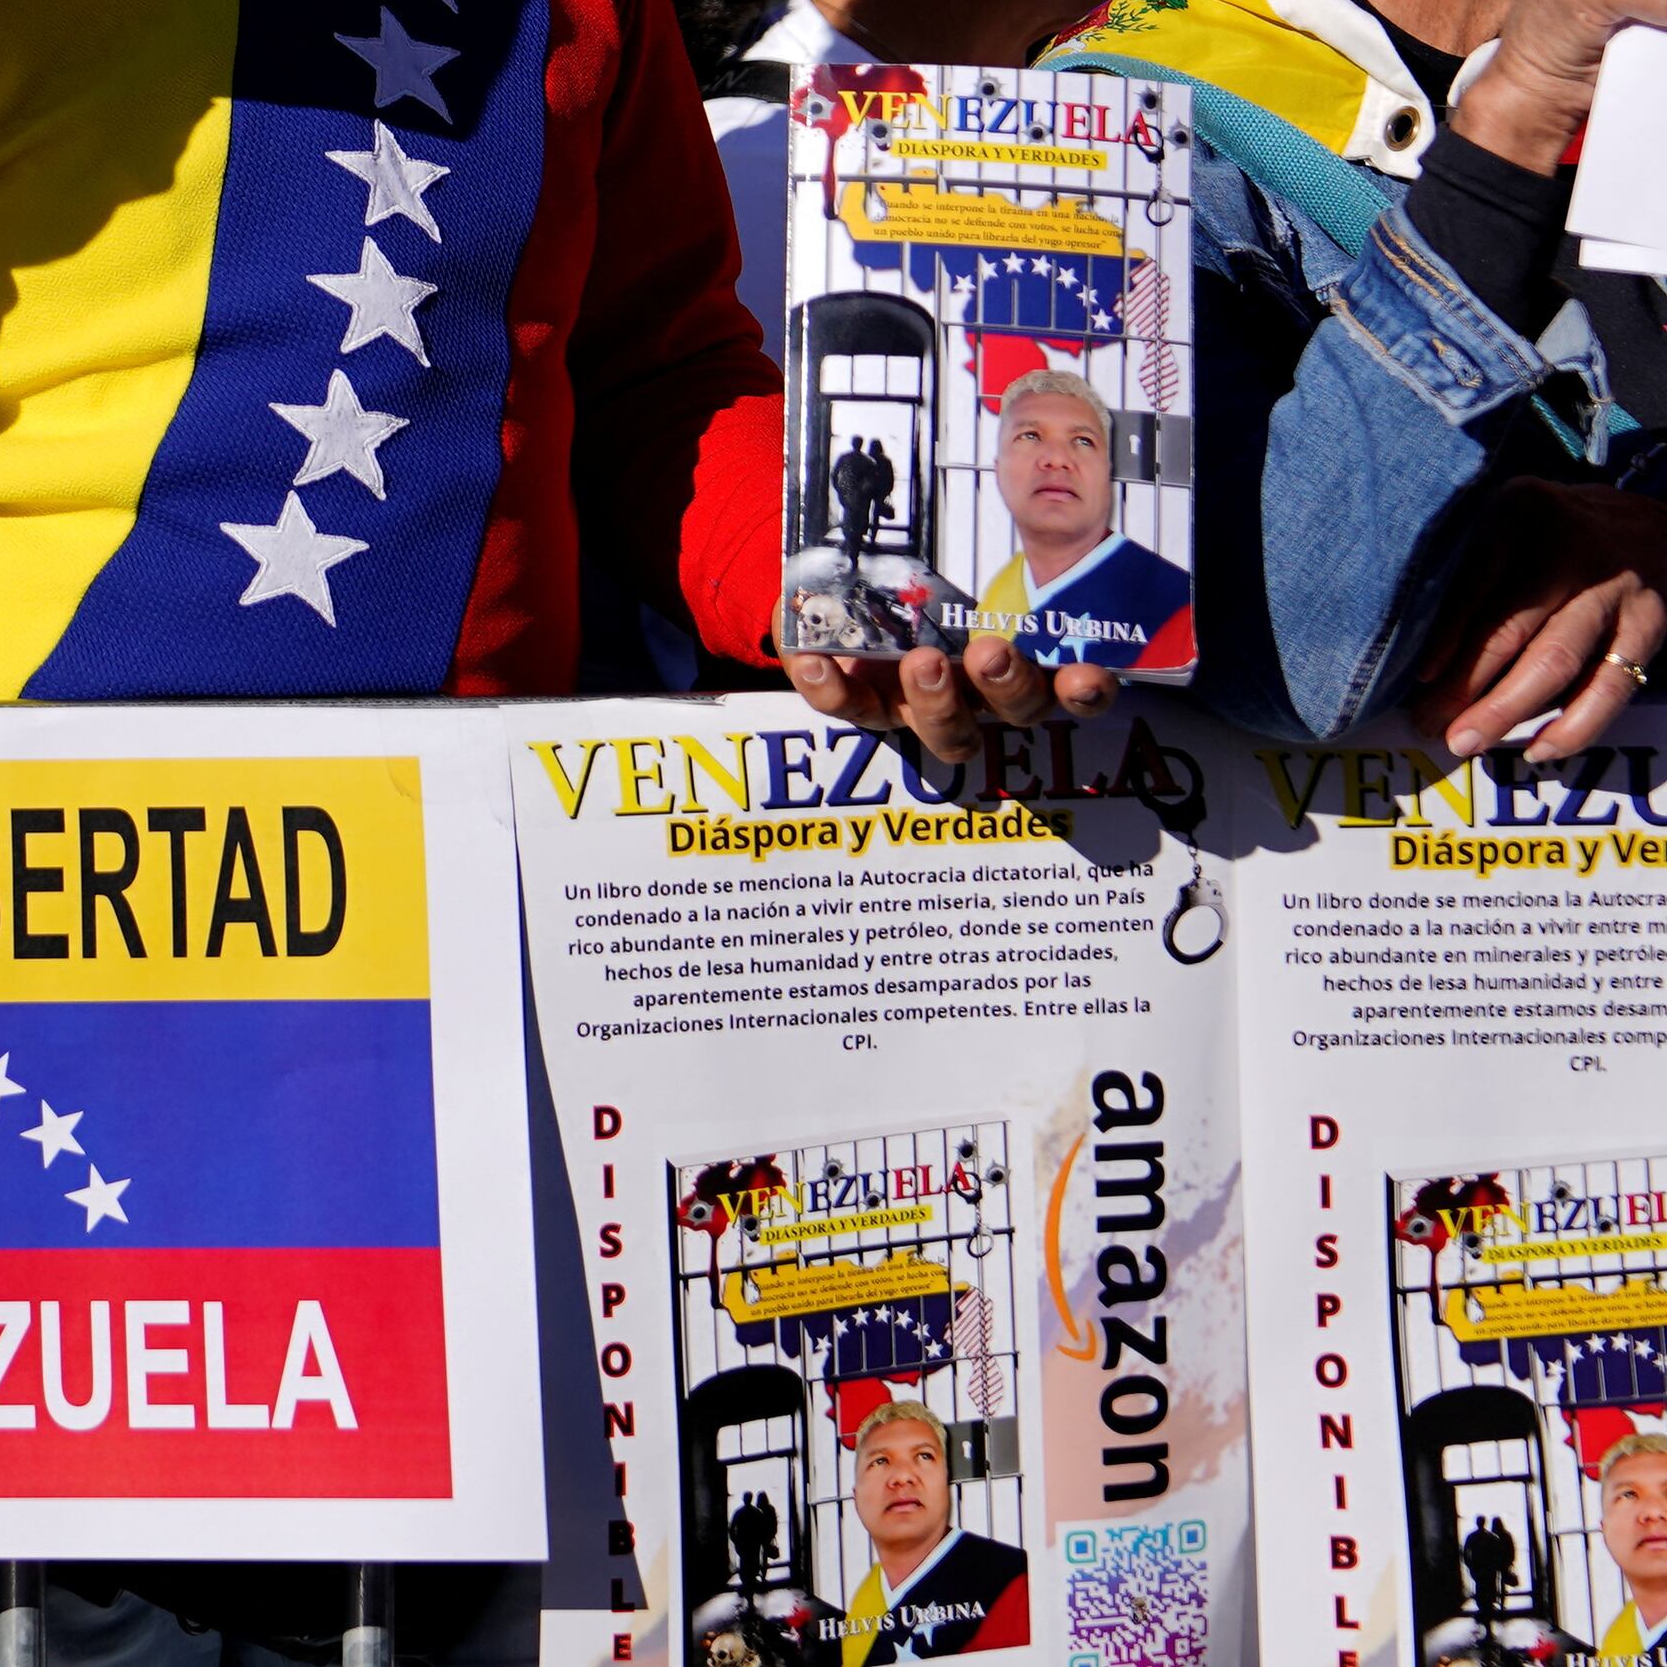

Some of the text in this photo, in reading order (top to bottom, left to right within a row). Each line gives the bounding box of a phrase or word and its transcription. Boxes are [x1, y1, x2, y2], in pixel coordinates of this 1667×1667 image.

[839, 90, 1157, 147] VENEZUELA
[1005, 148, 1101, 167] VERDADES
[940, 602, 1148, 644] HELVIS URBINA
[528, 716, 1186, 819] VENEZUELA
[670, 807, 1071, 859] Diáspora y Verdades
[1392, 832, 1667, 873] Diáspora y Ve
[1283, 894, 1310, 909] Un
[1318, 893, 1362, 909] libro
[1369, 892, 1430, 909] donde
[1436, 896, 1456, 908] se
[1463, 891, 1560, 908] menciona
[1566, 891, 1582, 907] la
[716, 1159, 973, 1228] VENEZUELA
[850, 1207, 927, 1228] VERDADES
[1091, 1069, 1170, 1503] amazon
[817, 1597, 986, 1642] HELVIS URBINA
